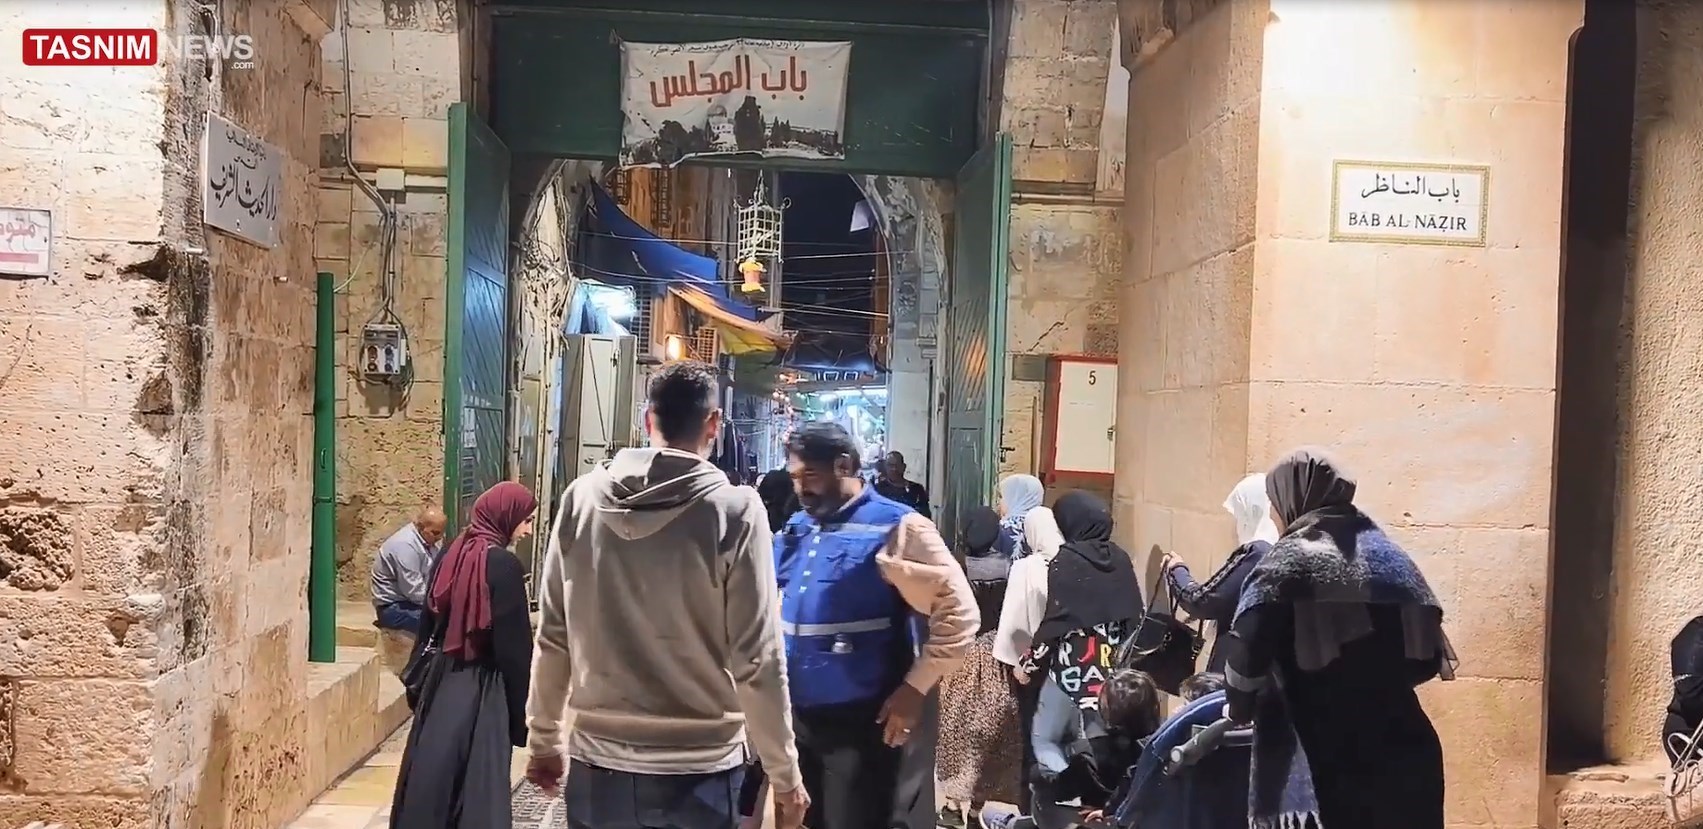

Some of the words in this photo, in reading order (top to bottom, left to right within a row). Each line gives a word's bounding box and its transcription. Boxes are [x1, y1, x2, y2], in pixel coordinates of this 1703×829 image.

[650, 54, 751, 108] المجلس
[761, 56, 807, 100] باب
[1361, 173, 1426, 199] الناظر
[1428, 178, 1460, 203] باب
[1088, 370, 1097, 386] 5
